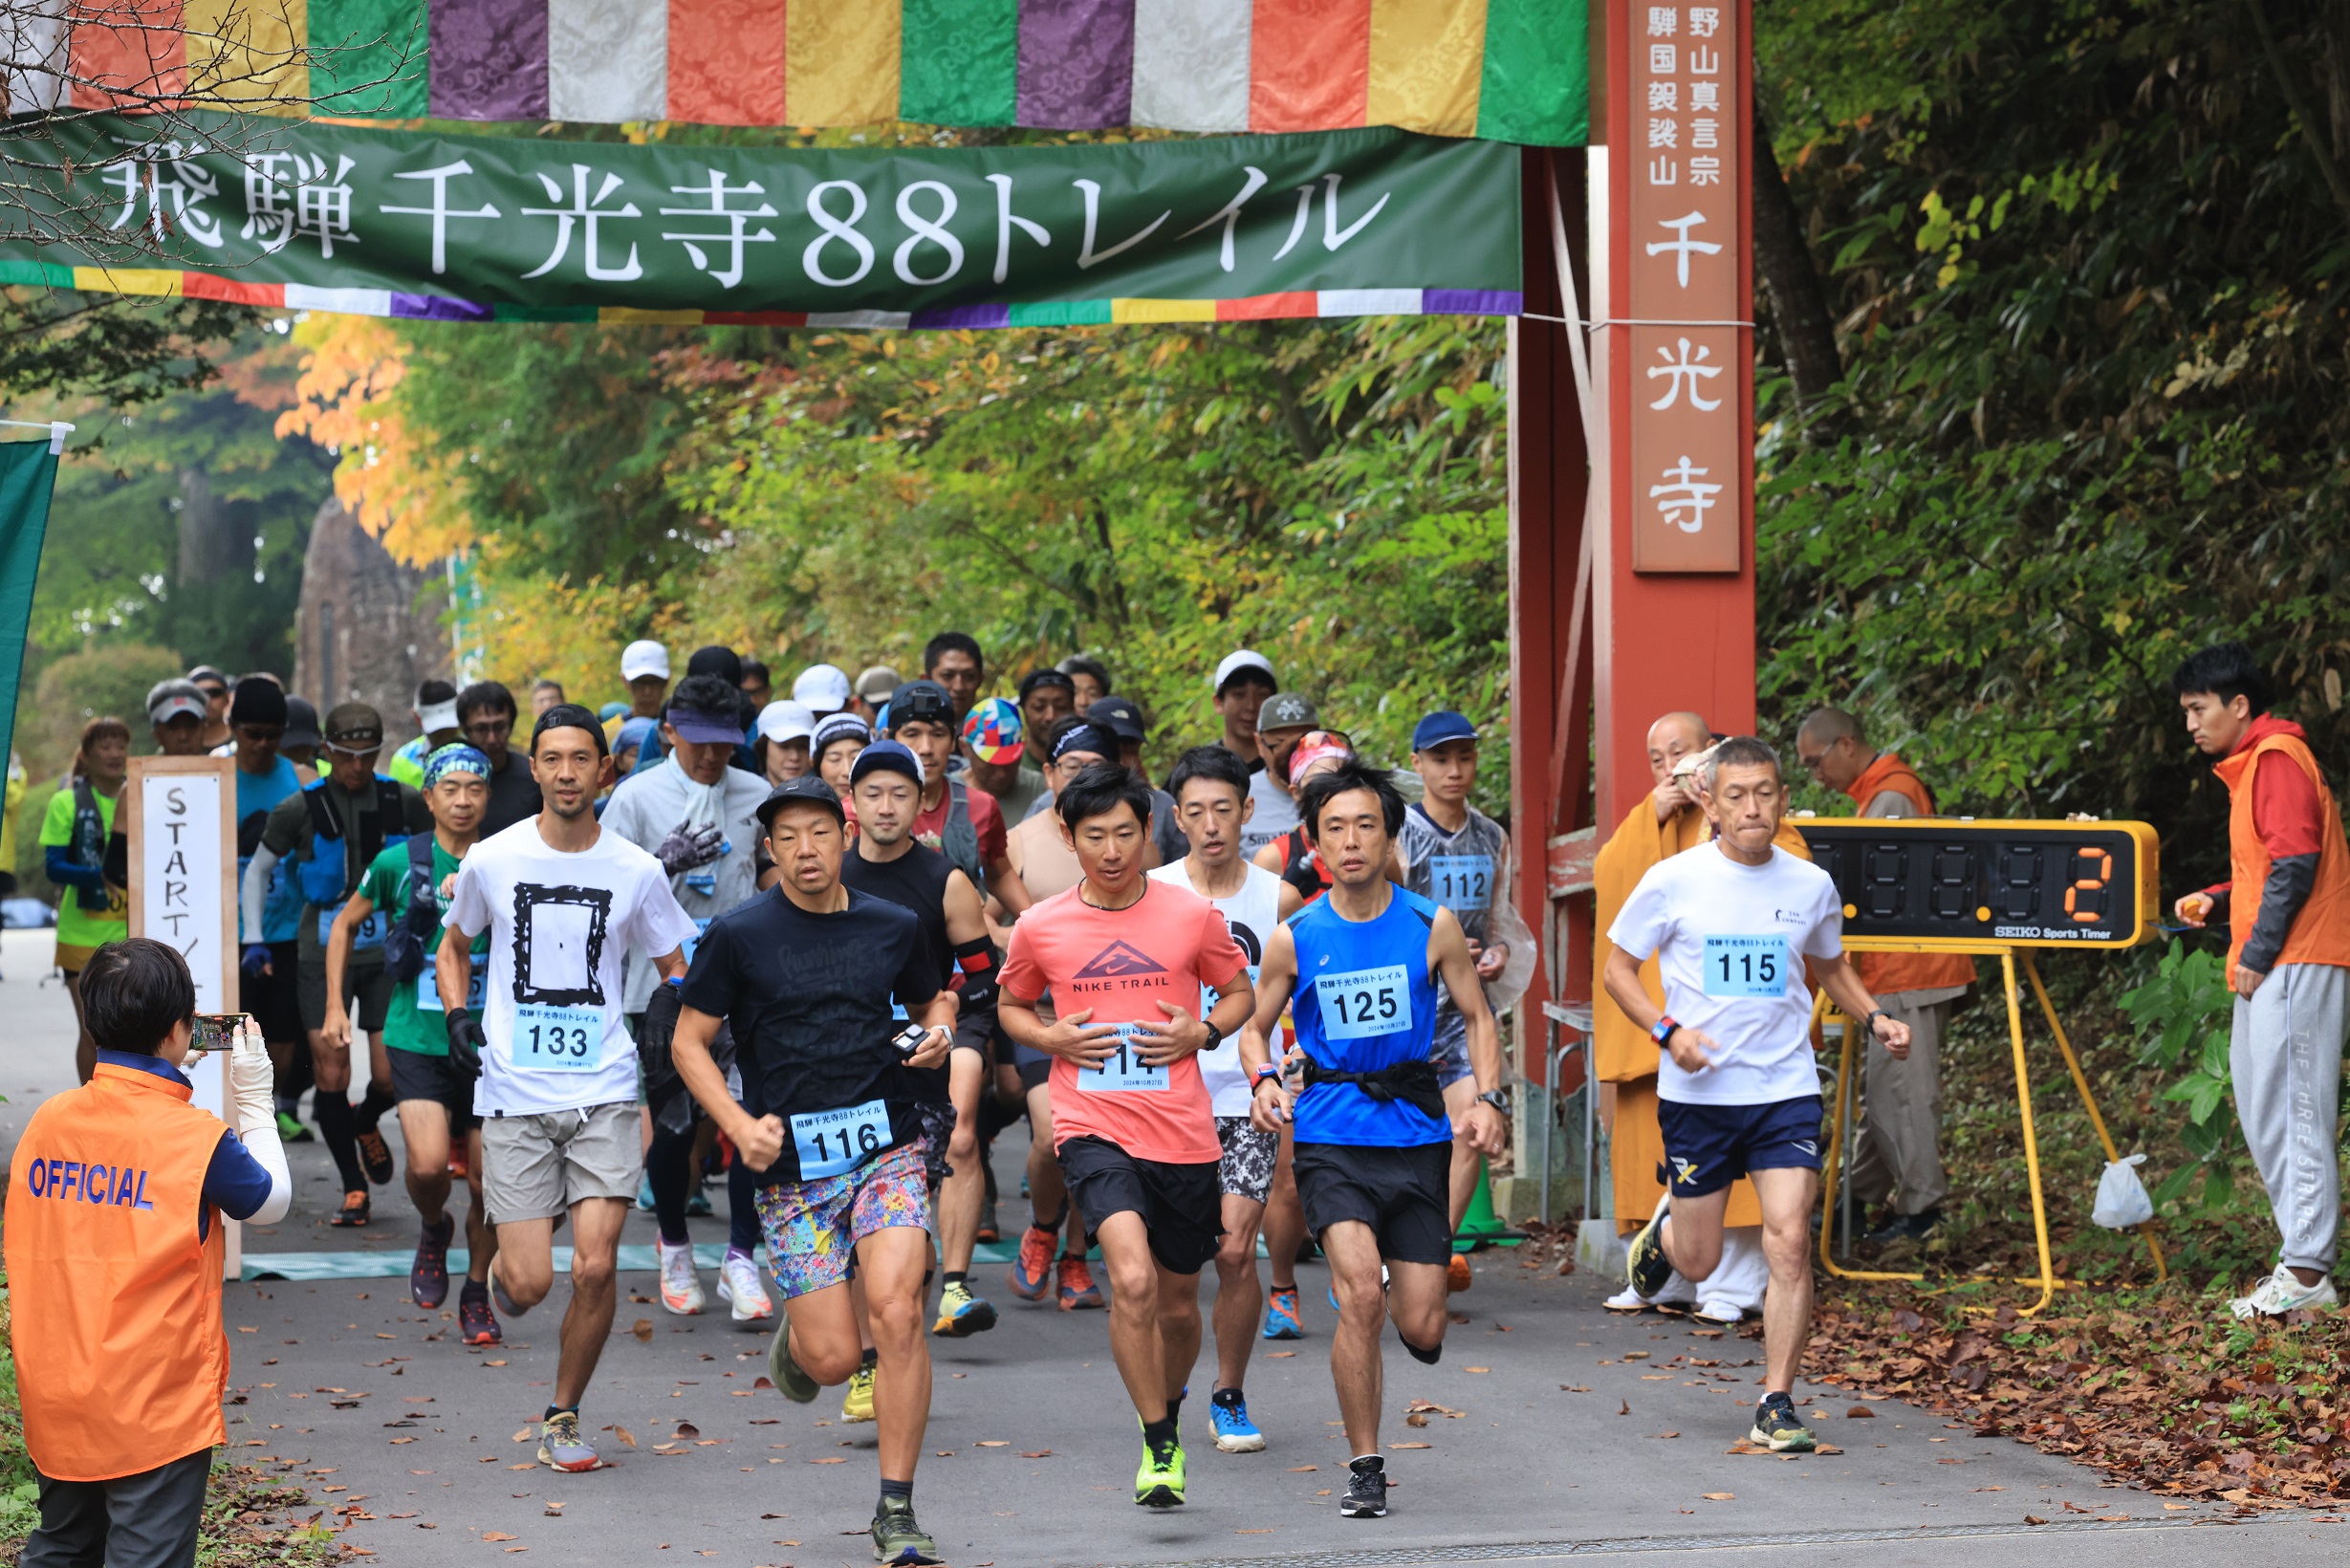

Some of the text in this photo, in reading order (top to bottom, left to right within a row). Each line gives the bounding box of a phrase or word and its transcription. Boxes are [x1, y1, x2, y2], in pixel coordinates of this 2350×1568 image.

[1689, 7, 1720, 186] 野山真言宗
[100, 134, 1392, 290] 飛騨千光寺88トレイル
[1645, 210, 1724, 534] 千光寺
[1443, 872, 1485, 898] 112
[1994, 926, 2111, 940] SEIKO Sports Timer
[1319, 971, 1403, 990] 飛騨千光寺88トレイル
[1718, 953, 1775, 983] 115
[1073, 977, 1169, 992] NIKE TRAIL
[518, 1009, 598, 1023] 飛騨千光寺88トレイル
[1334, 988, 1398, 1024] 125
[529, 1025, 587, 1057] 133
[795, 1106, 881, 1129] 飛騨千光寺88トレイル
[812, 1122, 880, 1163] 116
[2296, 1029, 2315, 1245] THE THREE STRIPES
[28, 1157, 154, 1211] OFFICIAL
